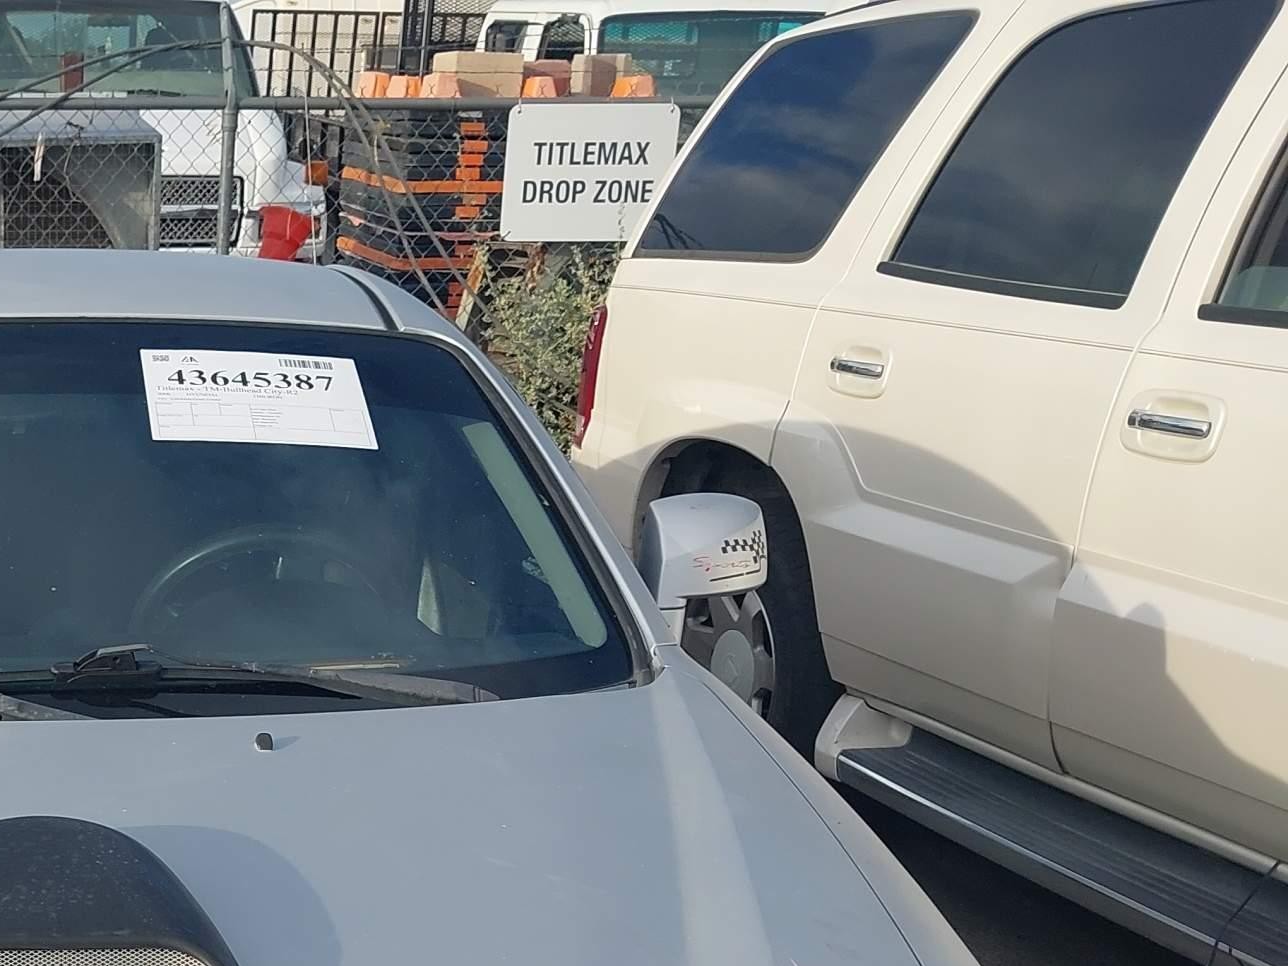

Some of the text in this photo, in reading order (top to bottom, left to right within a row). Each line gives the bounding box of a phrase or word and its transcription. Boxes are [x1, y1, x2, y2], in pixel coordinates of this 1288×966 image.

[534, 142, 651, 165] TITLEMAX
[522, 180, 654, 204] DROP ZONE
[167, 369, 333, 391] 43645387
